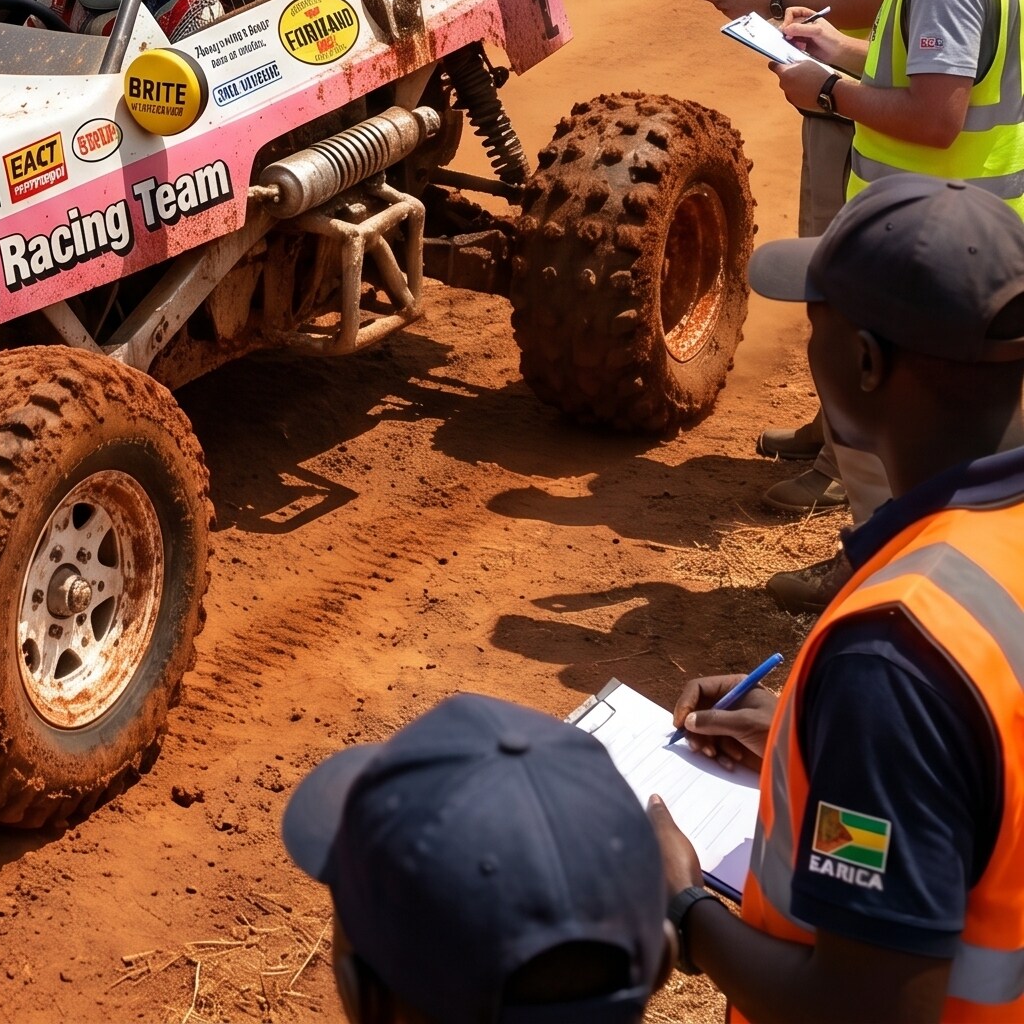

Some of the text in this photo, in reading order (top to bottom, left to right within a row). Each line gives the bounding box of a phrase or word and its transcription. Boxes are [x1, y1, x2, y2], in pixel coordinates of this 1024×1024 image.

[129, 77, 187, 105] BRITE
[10, 139, 57, 180] EACT
[133, 159, 234, 231] Team
